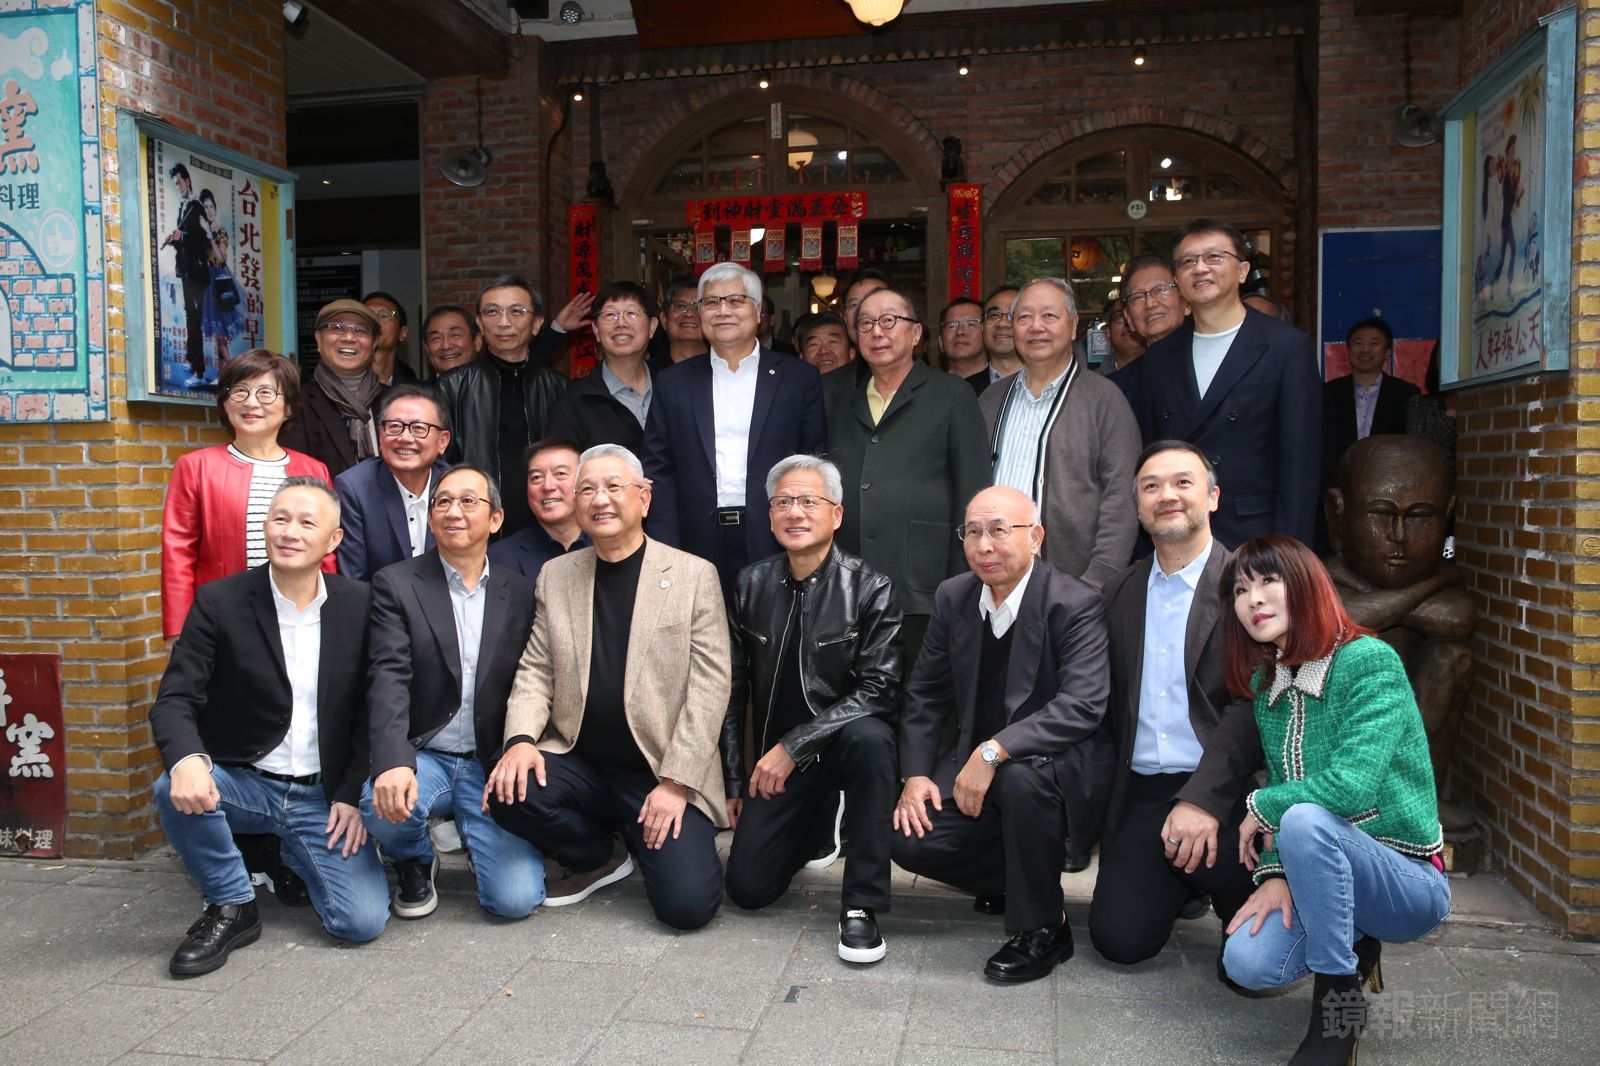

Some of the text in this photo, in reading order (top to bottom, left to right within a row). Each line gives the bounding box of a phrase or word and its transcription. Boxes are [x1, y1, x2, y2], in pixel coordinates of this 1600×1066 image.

[0, 80, 39, 175] 窯
[238, 179, 264, 349] 台北發的早
